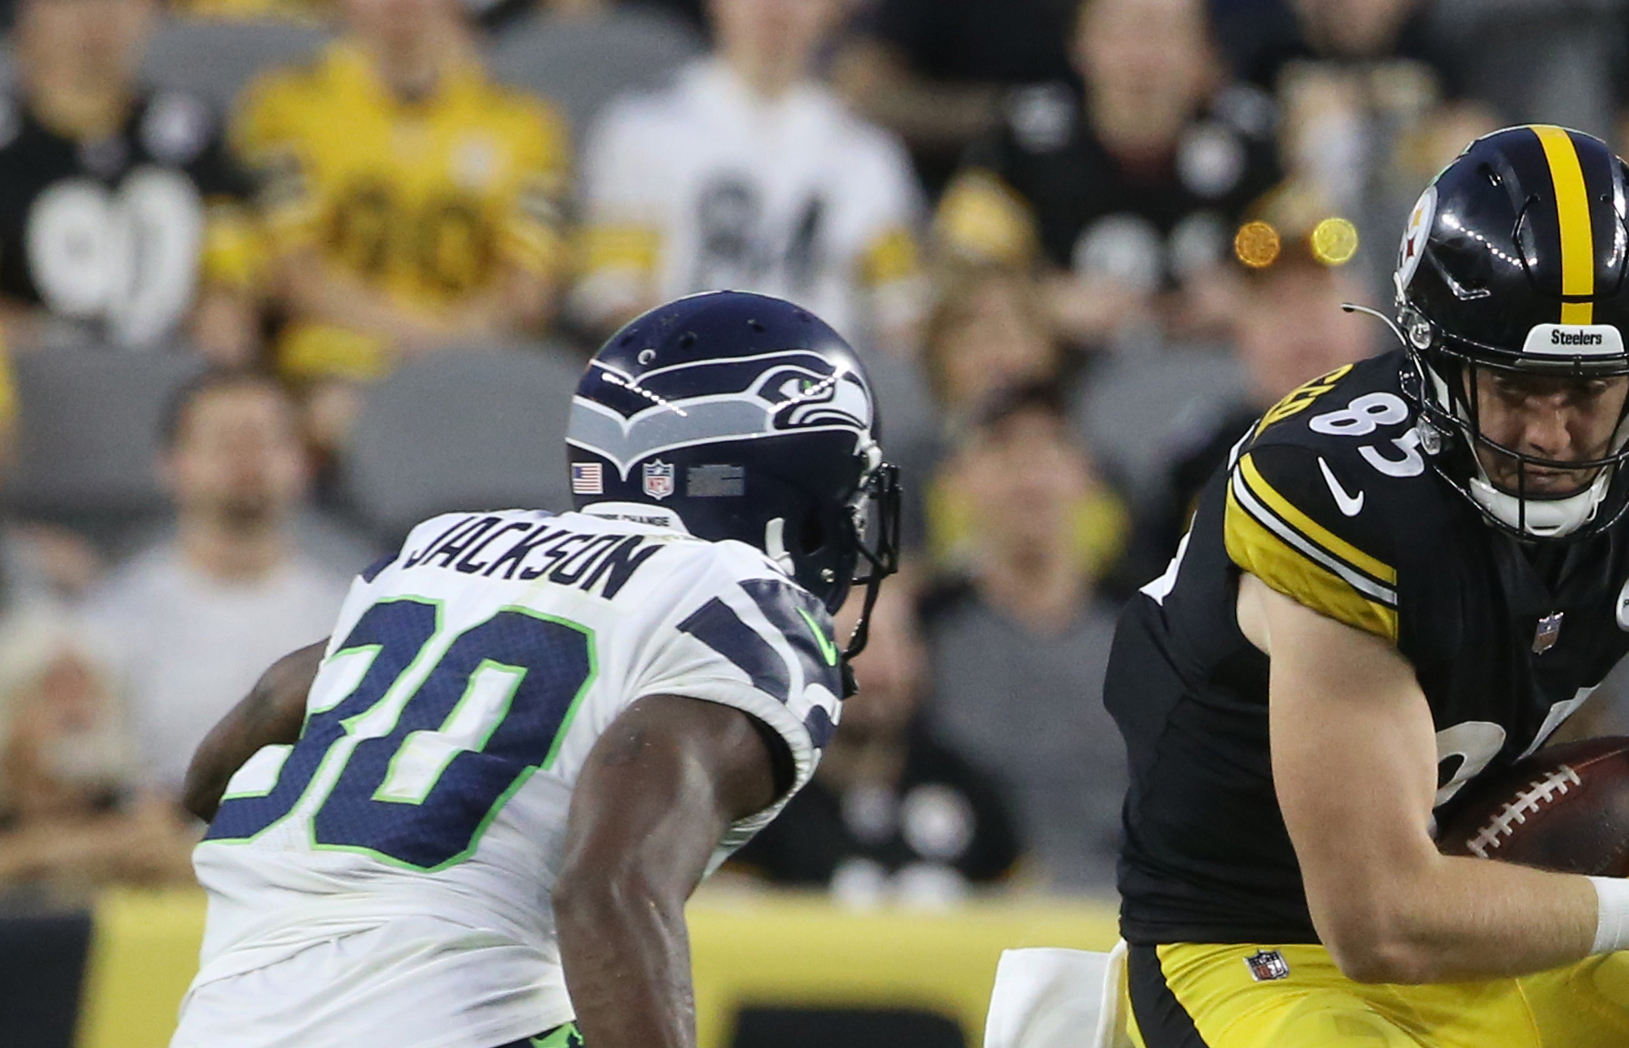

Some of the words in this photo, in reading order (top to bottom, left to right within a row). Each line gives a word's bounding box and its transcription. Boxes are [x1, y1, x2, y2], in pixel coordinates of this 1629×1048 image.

[1551, 329, 1602, 345] Steelers
[402, 516, 666, 601] JACKSON
[198, 594, 599, 873] 30
